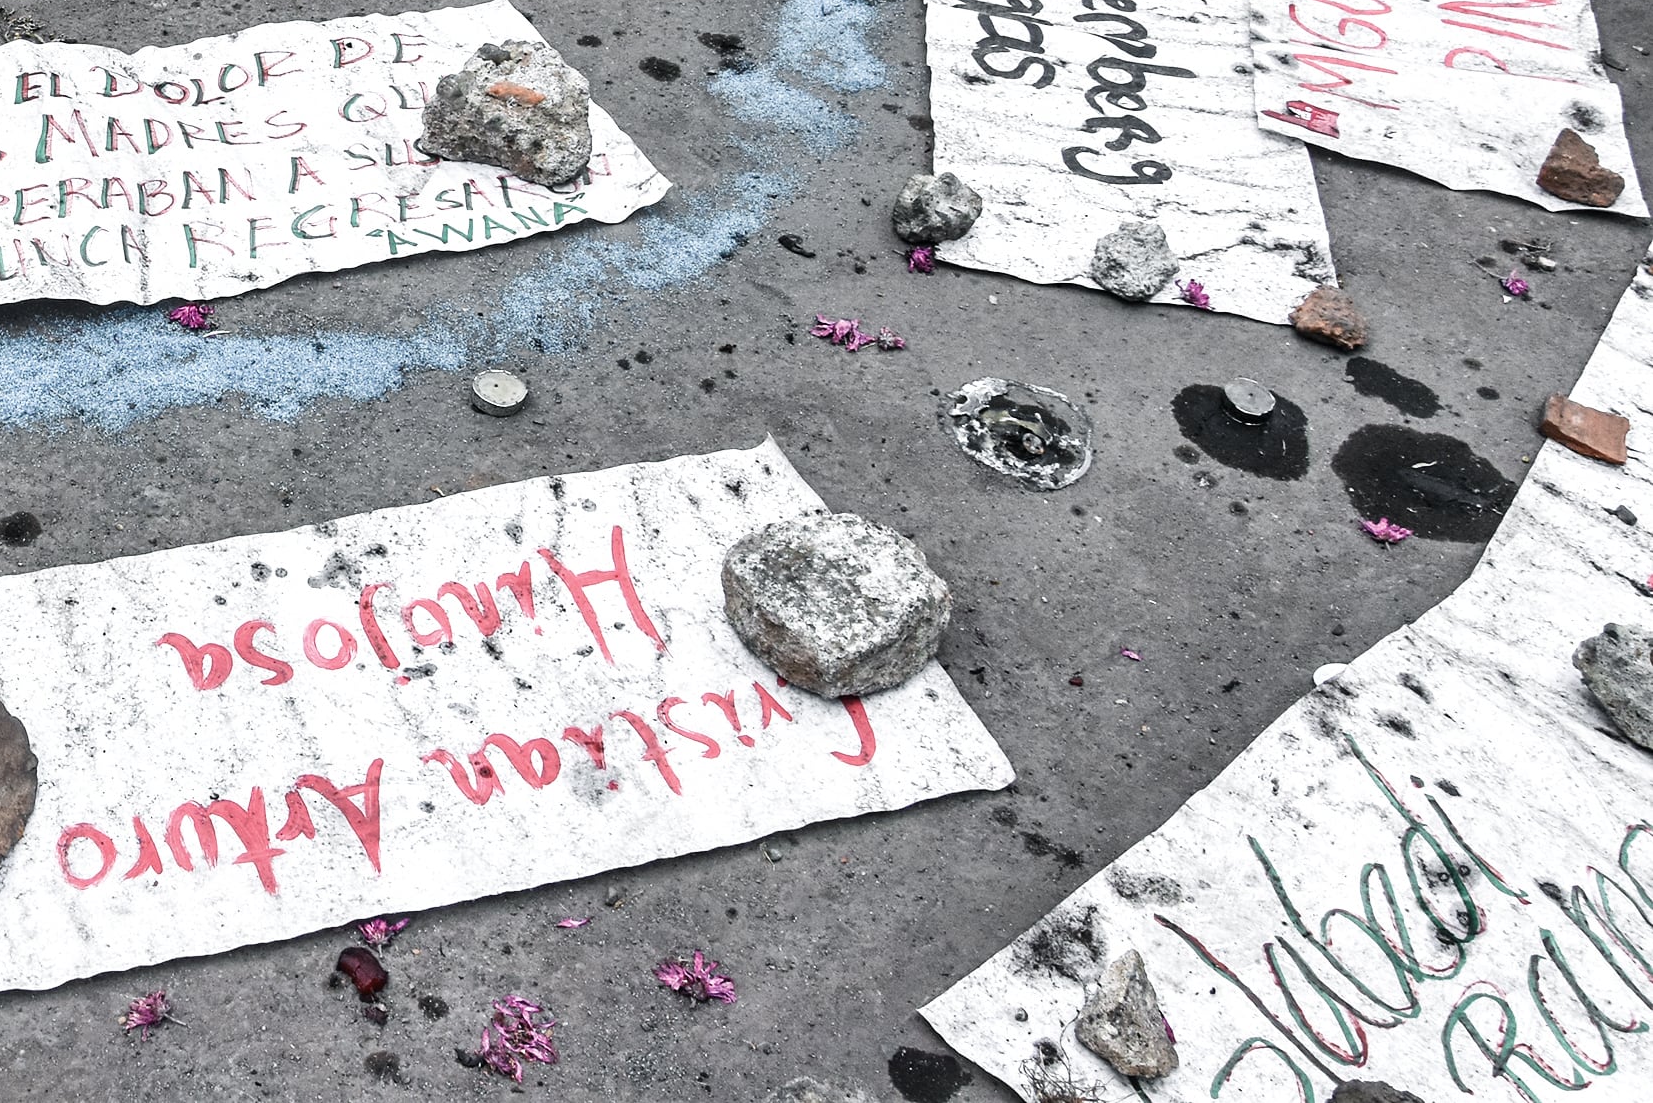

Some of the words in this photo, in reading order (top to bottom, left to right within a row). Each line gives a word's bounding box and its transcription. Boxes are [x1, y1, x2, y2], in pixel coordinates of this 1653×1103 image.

[15, 70, 72, 104] EL
[95, 51, 303, 106] DOLOR
[330, 33, 428, 68] DE
[36, 109, 308, 164] MADRES
[339, 81, 429, 123] QU
[290, 156, 325, 195] A
[152, 524, 670, 694] Hinojosa
[54, 757, 386, 897] Arturo
